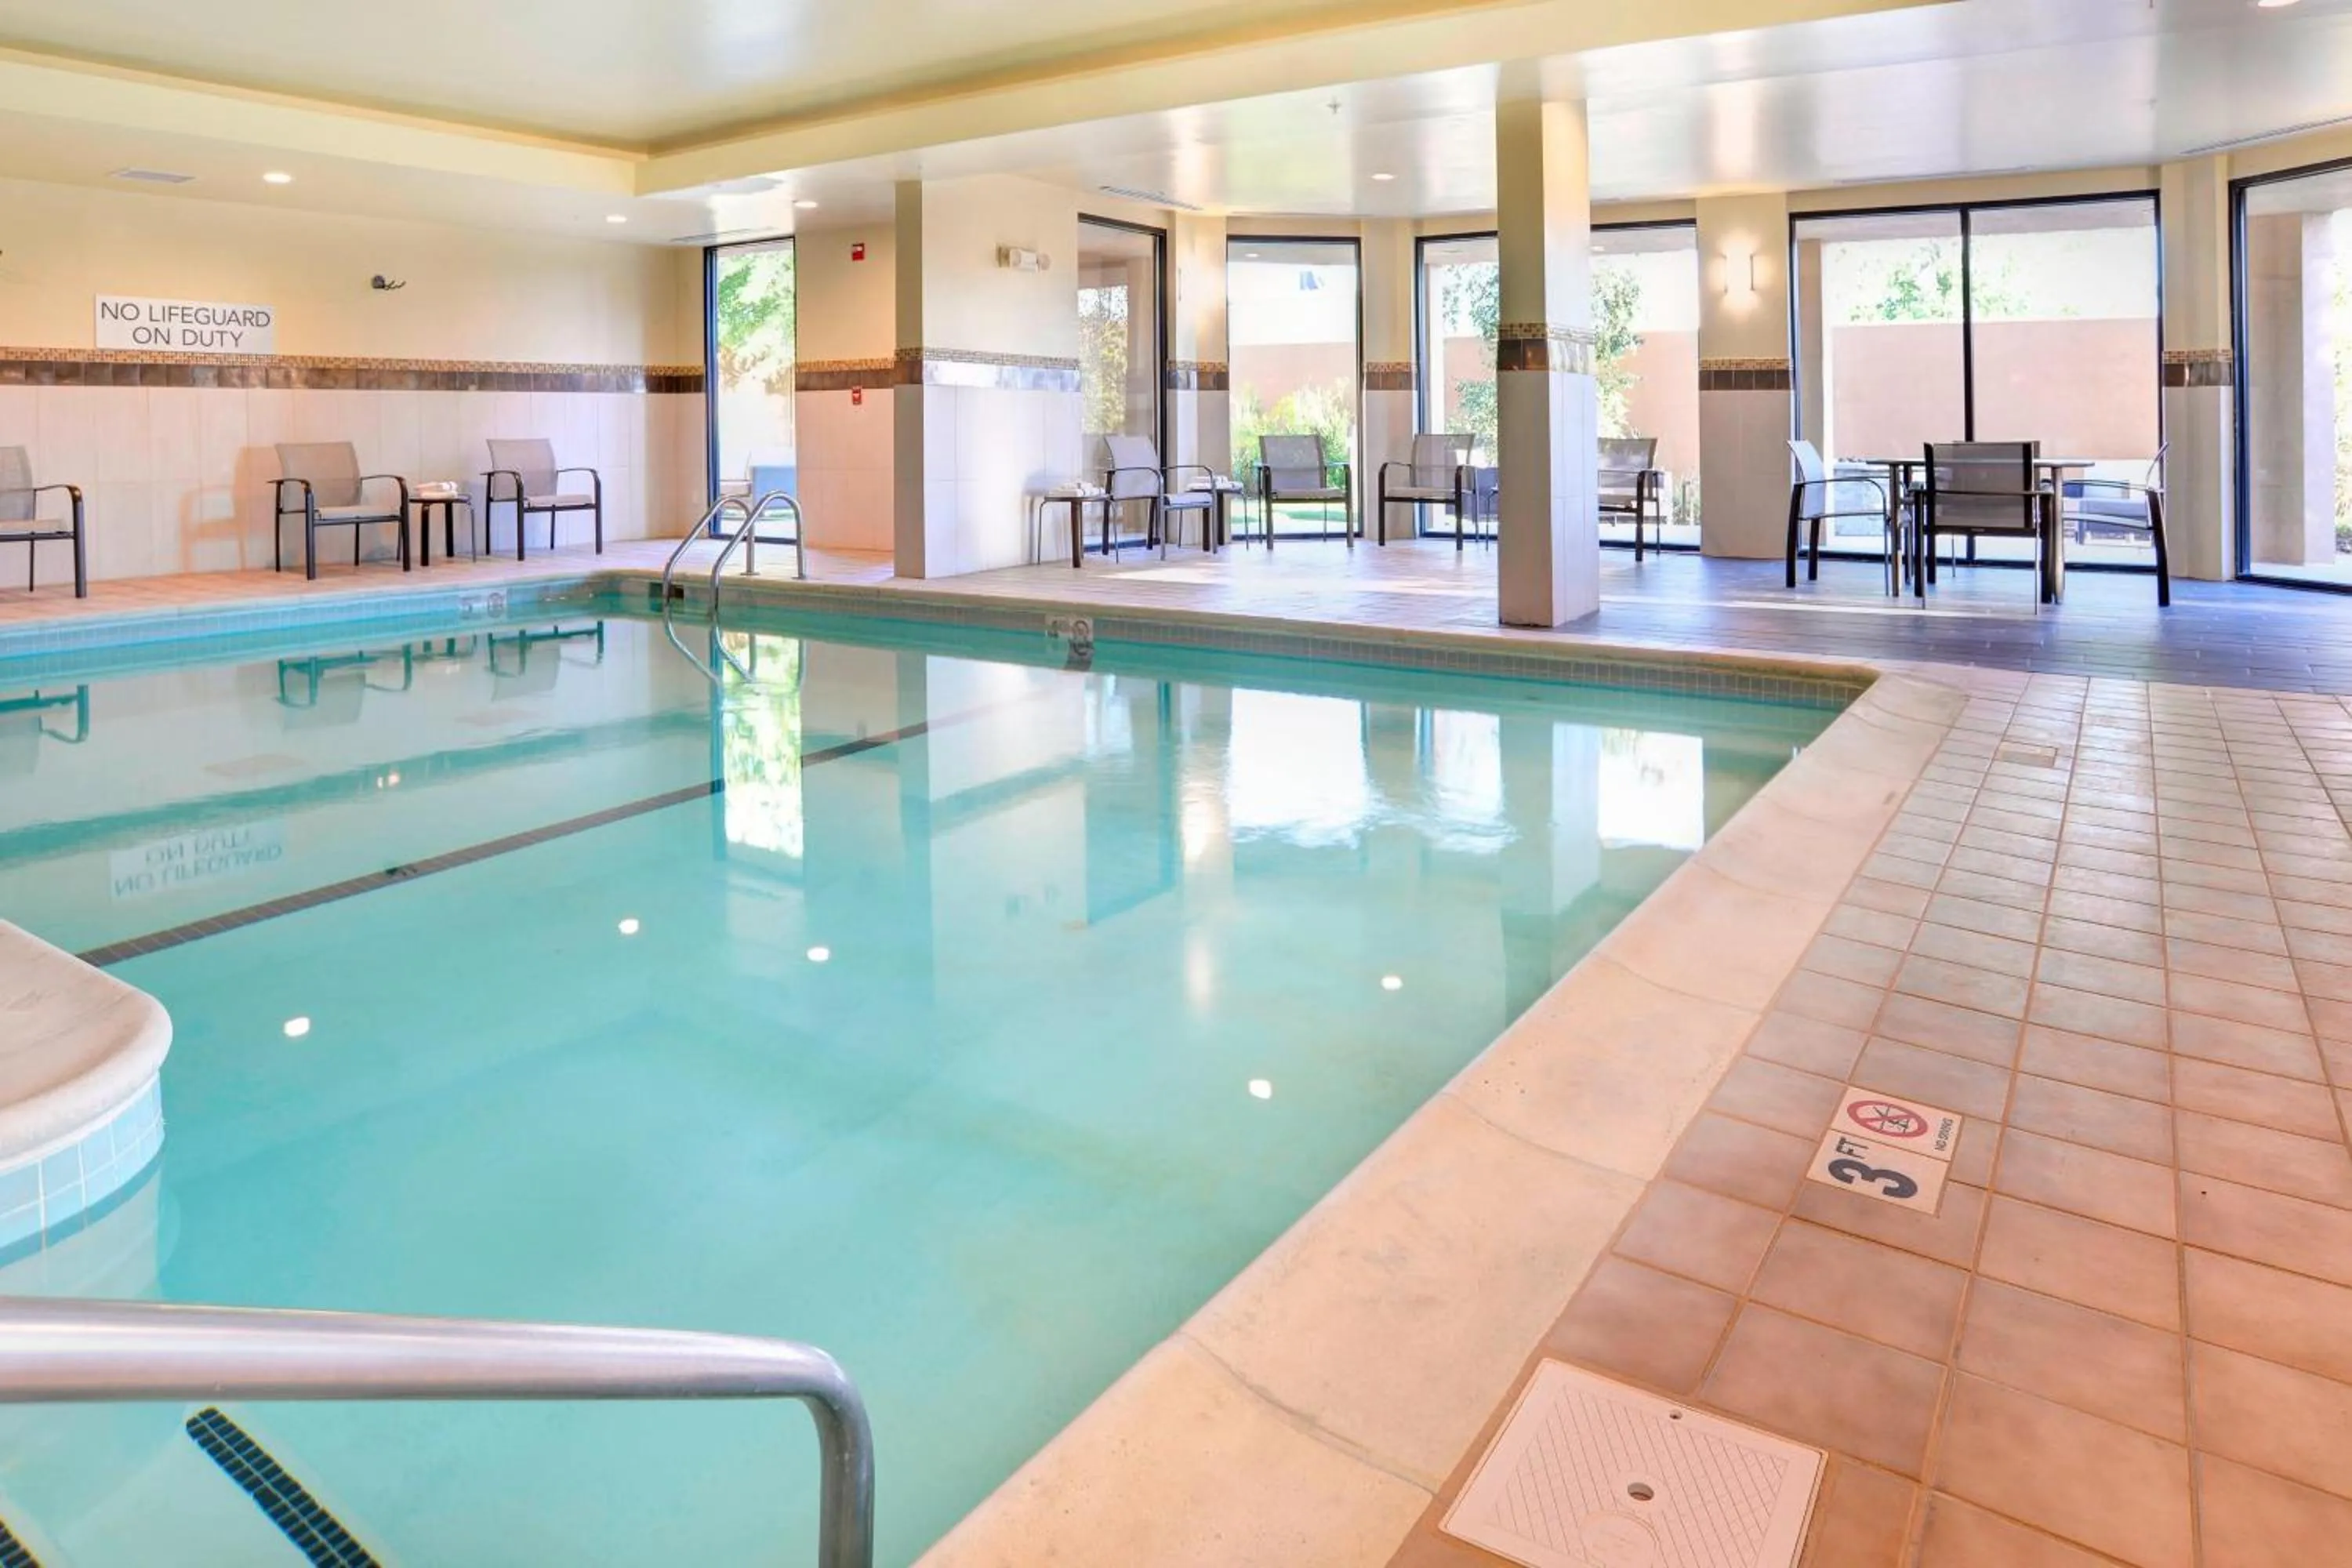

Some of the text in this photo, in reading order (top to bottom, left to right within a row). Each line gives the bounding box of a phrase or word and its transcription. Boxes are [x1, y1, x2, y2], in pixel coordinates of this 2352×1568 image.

[101, 302, 270, 328] NO LIFEGUARD
[132, 326, 244, 347] ON DUTY
[1828, 1137, 1918, 1199] 3 FT
